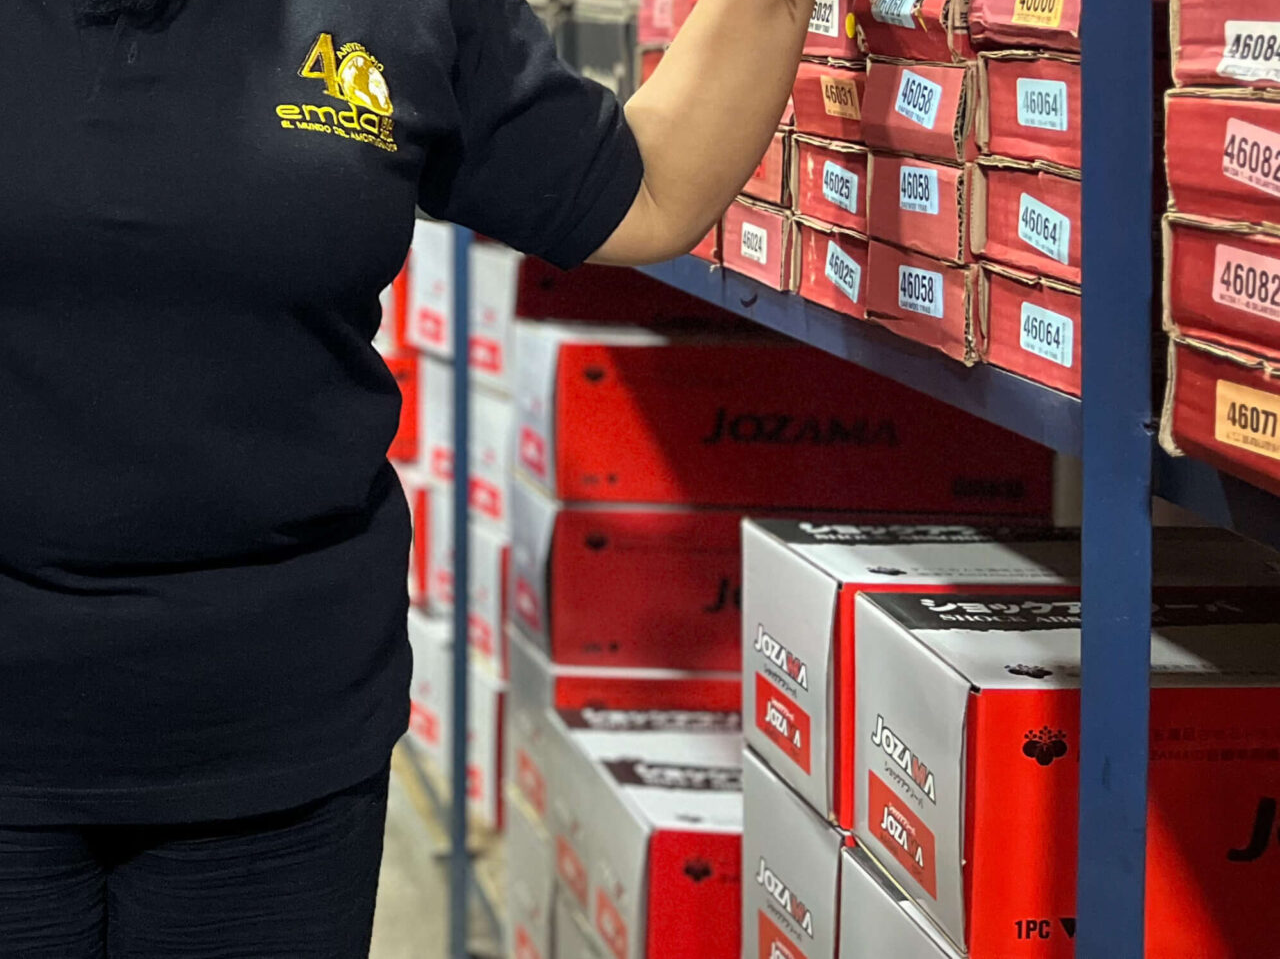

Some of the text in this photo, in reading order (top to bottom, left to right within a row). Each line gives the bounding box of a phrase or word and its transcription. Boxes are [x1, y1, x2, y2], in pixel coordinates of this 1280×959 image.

[812, 1, 833, 23] 6032
[824, 84, 855, 107] 46031
[901, 71, 934, 116] 46058
[1022, 89, 1059, 117] 46064
[281, 120, 295, 129] EL
[824, 169, 851, 200] 46025
[901, 170, 930, 197] 46058
[1021, 205, 1058, 246] 46064
[828, 251, 856, 290] 46025
[1220, 260, 1280, 308] 46082
[900, 271, 934, 304] 46058
[1023, 316, 1061, 350] 46064
[938, 614, 1026, 623] SHOCK
[754, 622, 809, 693] JOZAMA
[871, 713, 937, 806] JOZAMA
[756, 855, 815, 940] JOZAMA
[1014, 918, 1051, 940] 1PC
